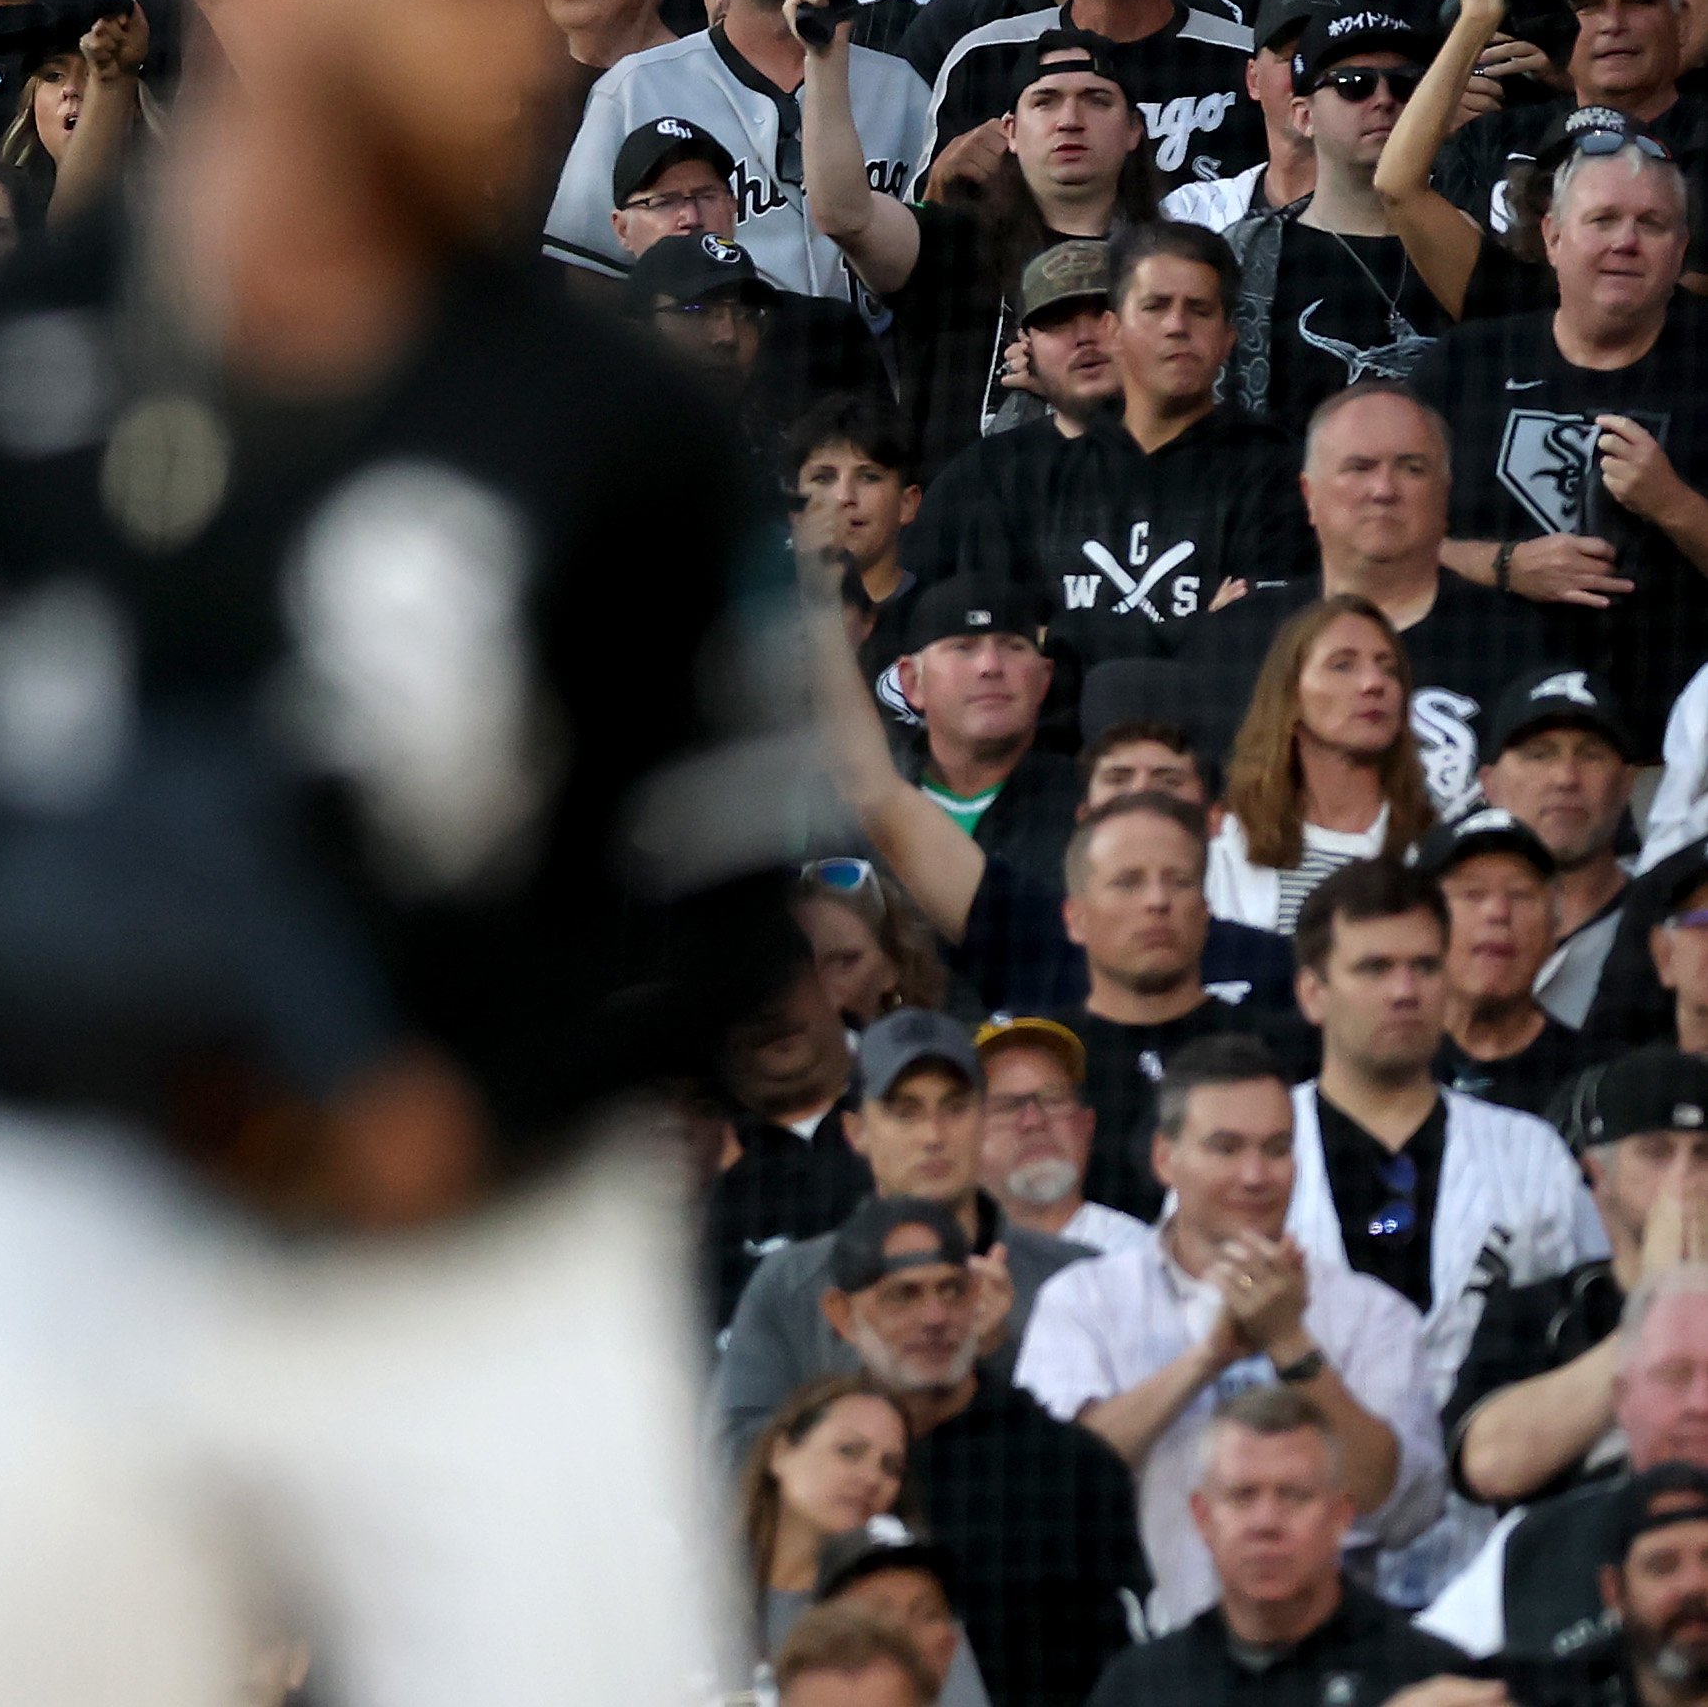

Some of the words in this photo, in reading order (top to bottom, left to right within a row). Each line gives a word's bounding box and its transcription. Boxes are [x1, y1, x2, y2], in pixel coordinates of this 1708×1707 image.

[1131, 521, 1151, 567] C
[1063, 575, 1098, 611] W
[1169, 575, 1199, 615] S
